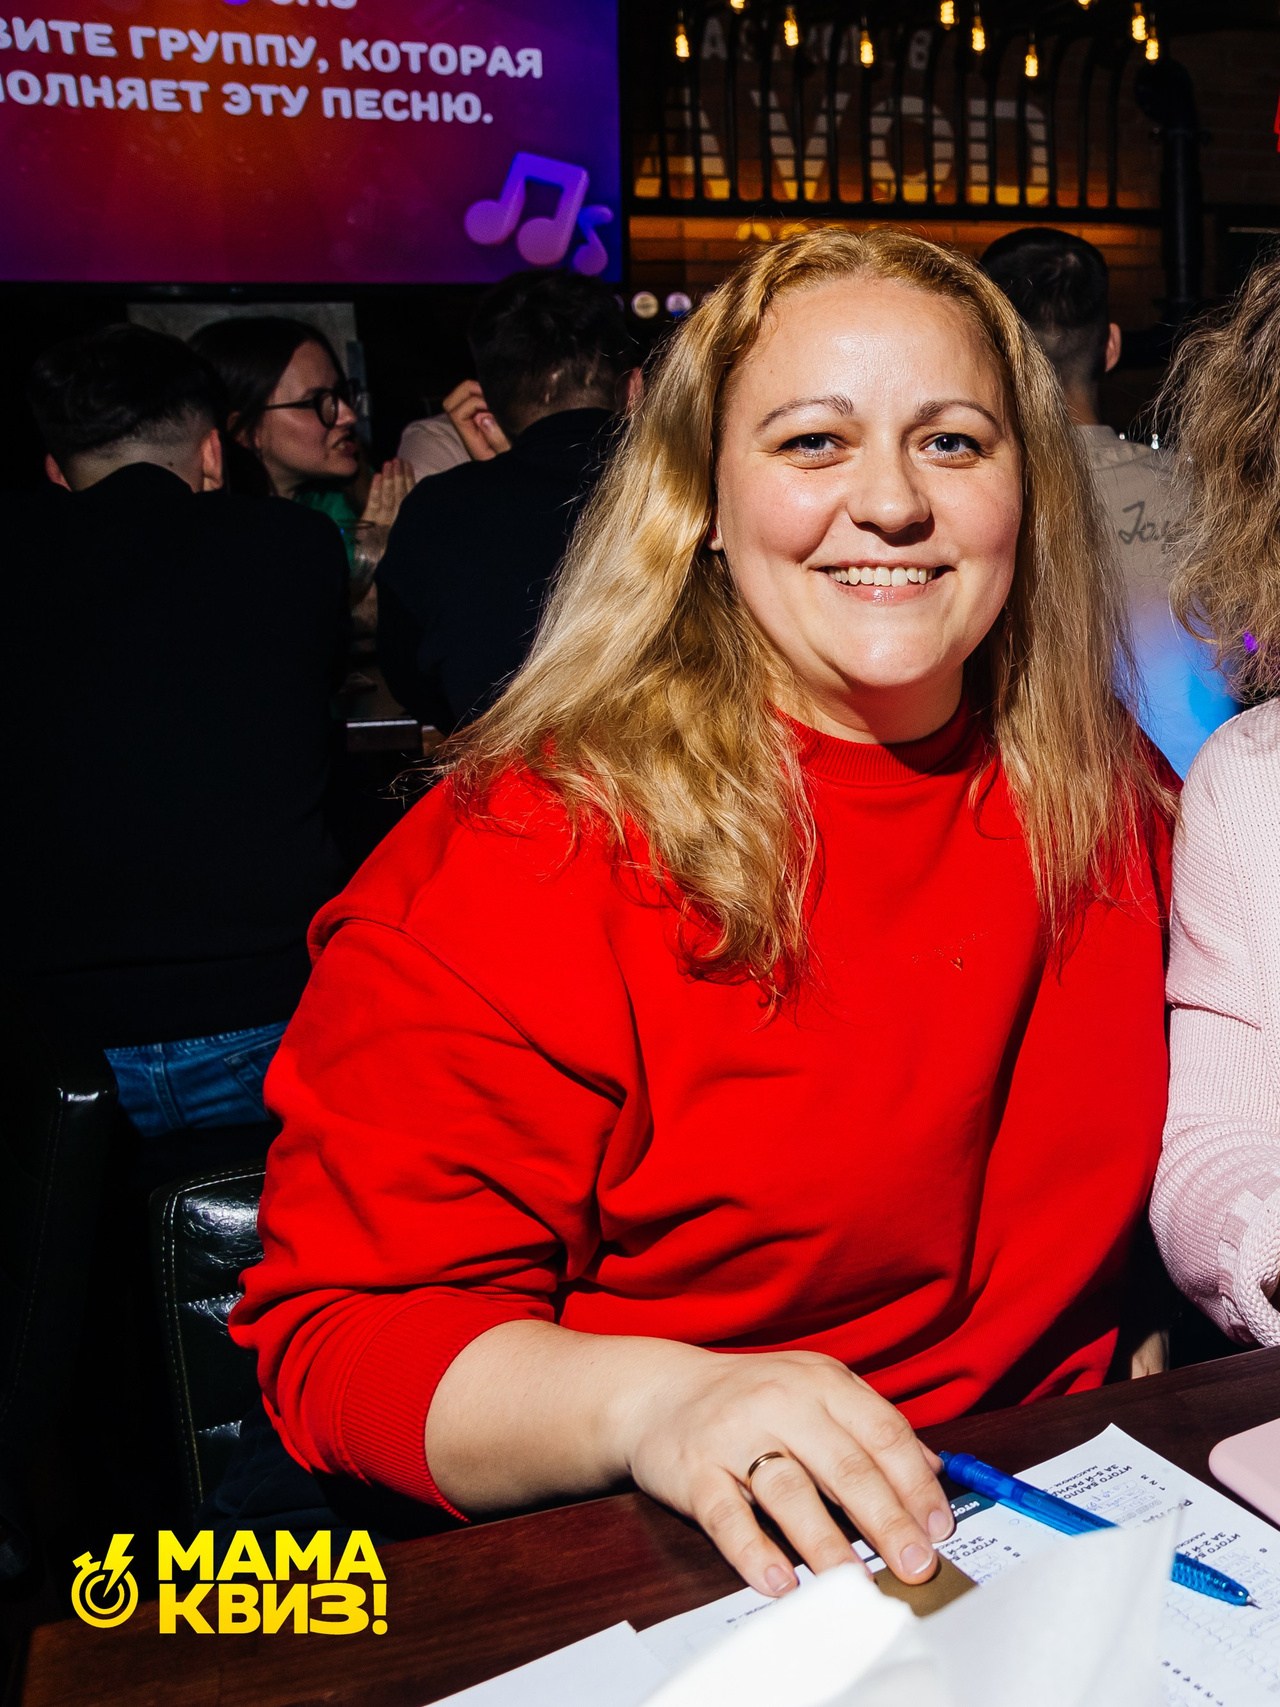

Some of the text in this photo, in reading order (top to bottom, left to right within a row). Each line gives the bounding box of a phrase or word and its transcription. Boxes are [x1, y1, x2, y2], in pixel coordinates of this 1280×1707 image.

[129, 25, 329, 74] ГРУППУ,
[340, 38, 544, 79] КОТОРАЯ
[0, 70, 494, 124] ОЛНЯЕТ ЭТУ ПЕСНЮ.
[1100, 1465, 1132, 1483] ИТОГО
[1063, 1481, 1099, 1499] БАЛЛО
[962, 1538, 998, 1557] ИТОГО
[1207, 1533, 1241, 1554] ИТОГО
